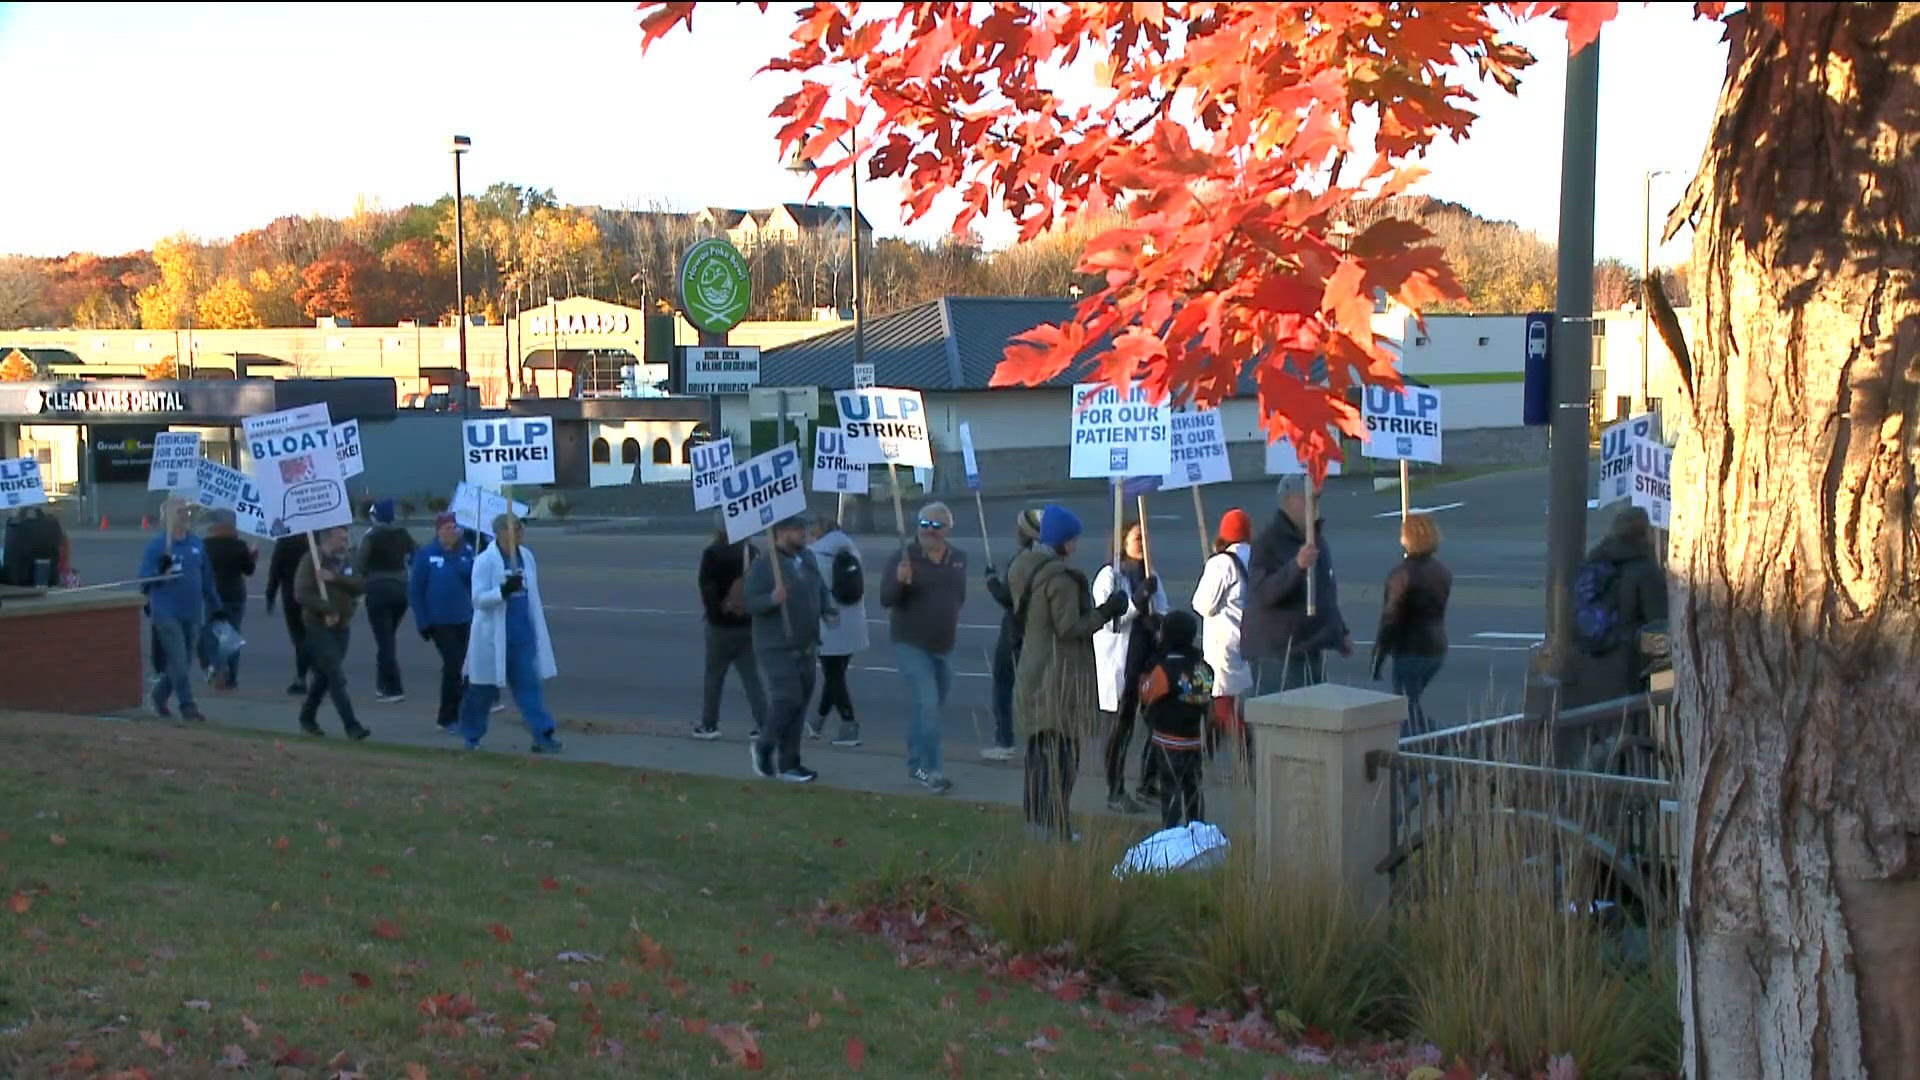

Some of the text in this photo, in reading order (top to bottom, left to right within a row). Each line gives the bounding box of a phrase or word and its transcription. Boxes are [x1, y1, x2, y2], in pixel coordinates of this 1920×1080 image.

[710, 246, 729, 259] Poke
[46, 391, 183, 411] CLEAR LAKES DENTAL
[1077, 387, 1150, 405] STRIIN
[1366, 386, 1438, 418] ULP
[840, 395, 918, 420] ULP
[1079, 407, 1158, 425] FOR OUR
[847, 422, 923, 440] STRIKE!
[1171, 414, 1214, 430] IKING
[1367, 415, 1438, 437] STRIKE!
[252, 428, 329, 460] BLOAT
[334, 425, 356, 449] LP
[467, 423, 548, 447] ULP
[1076, 425, 1166, 444] PATIENTS!
[1188, 430, 1215, 444] OUR
[174, 446, 194, 456] OUR
[469, 447, 548, 464] STRIKE!
[692, 443, 730, 472] ULP
[1171, 443, 1224, 462] TIENTS!
[1, 461, 37, 479] LP
[722, 449, 794, 499] ULP
[0, 477, 39, 491] RIKE!
[215, 477, 240, 493] OUR
[1635, 474, 1671, 501] STRIKE
[727, 474, 798, 517] STRIKE!
